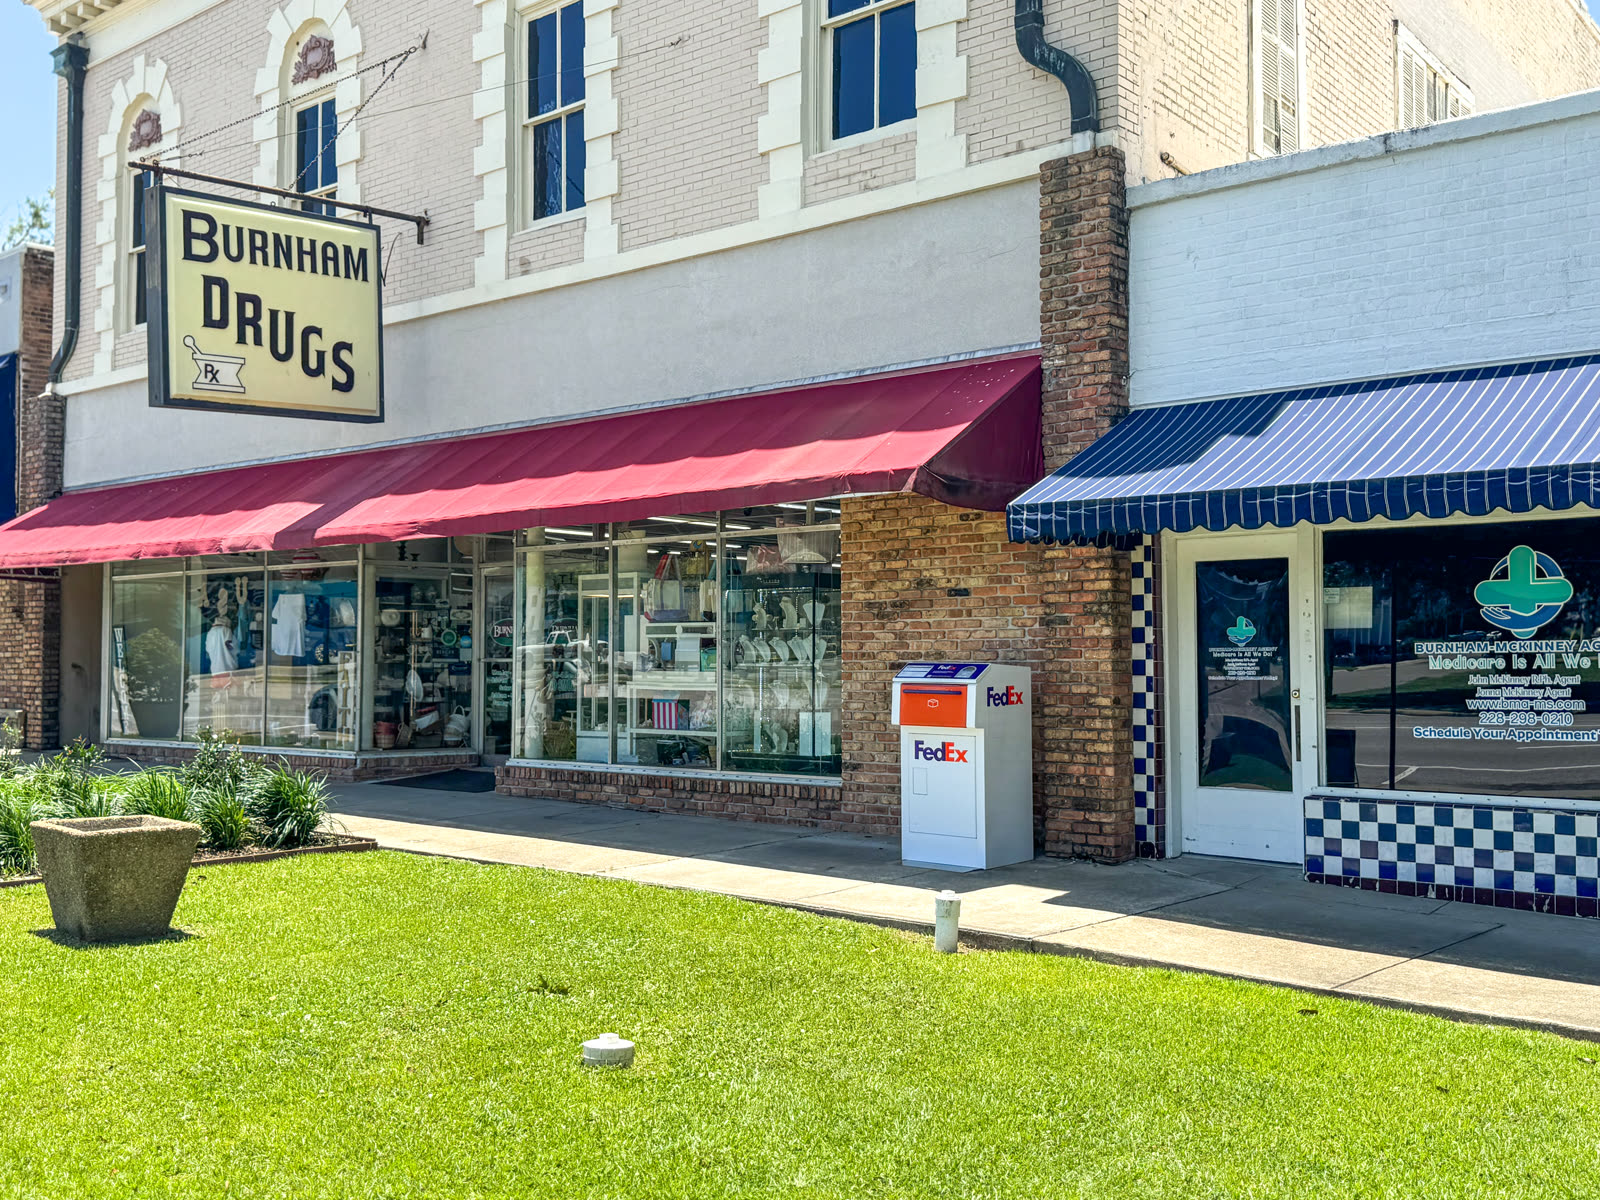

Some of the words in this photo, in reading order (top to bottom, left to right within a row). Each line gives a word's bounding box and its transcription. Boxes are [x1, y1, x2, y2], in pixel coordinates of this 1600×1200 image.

[181, 209, 369, 282] BURNHAM
[201, 274, 354, 393] DRUGS
[1414, 640, 1577, 655] BURNHAM-MCKINNEY
[1428, 655, 1506, 670] Medicare
[1512, 654, 1527, 669] Is
[1533, 653, 1556, 669] All
[1561, 653, 1592, 669] We
[1468, 675, 1489, 685] John
[1489, 674, 1530, 687] McKinney
[1554, 674, 1581, 686] Agent
[986, 685, 1024, 707] FedEx
[1475, 687, 1501, 697] Jonna
[1502, 686, 1544, 699] McKinney
[1544, 687, 1572, 699] Agent
[1465, 697, 1586, 711] www.bma-ms.com
[1478, 712, 1574, 726] 228-298-0210
[1413, 726, 1471, 739] Schedule
[1506, 727, 1597, 742] Appointment
[914, 739, 968, 763] FedEx
